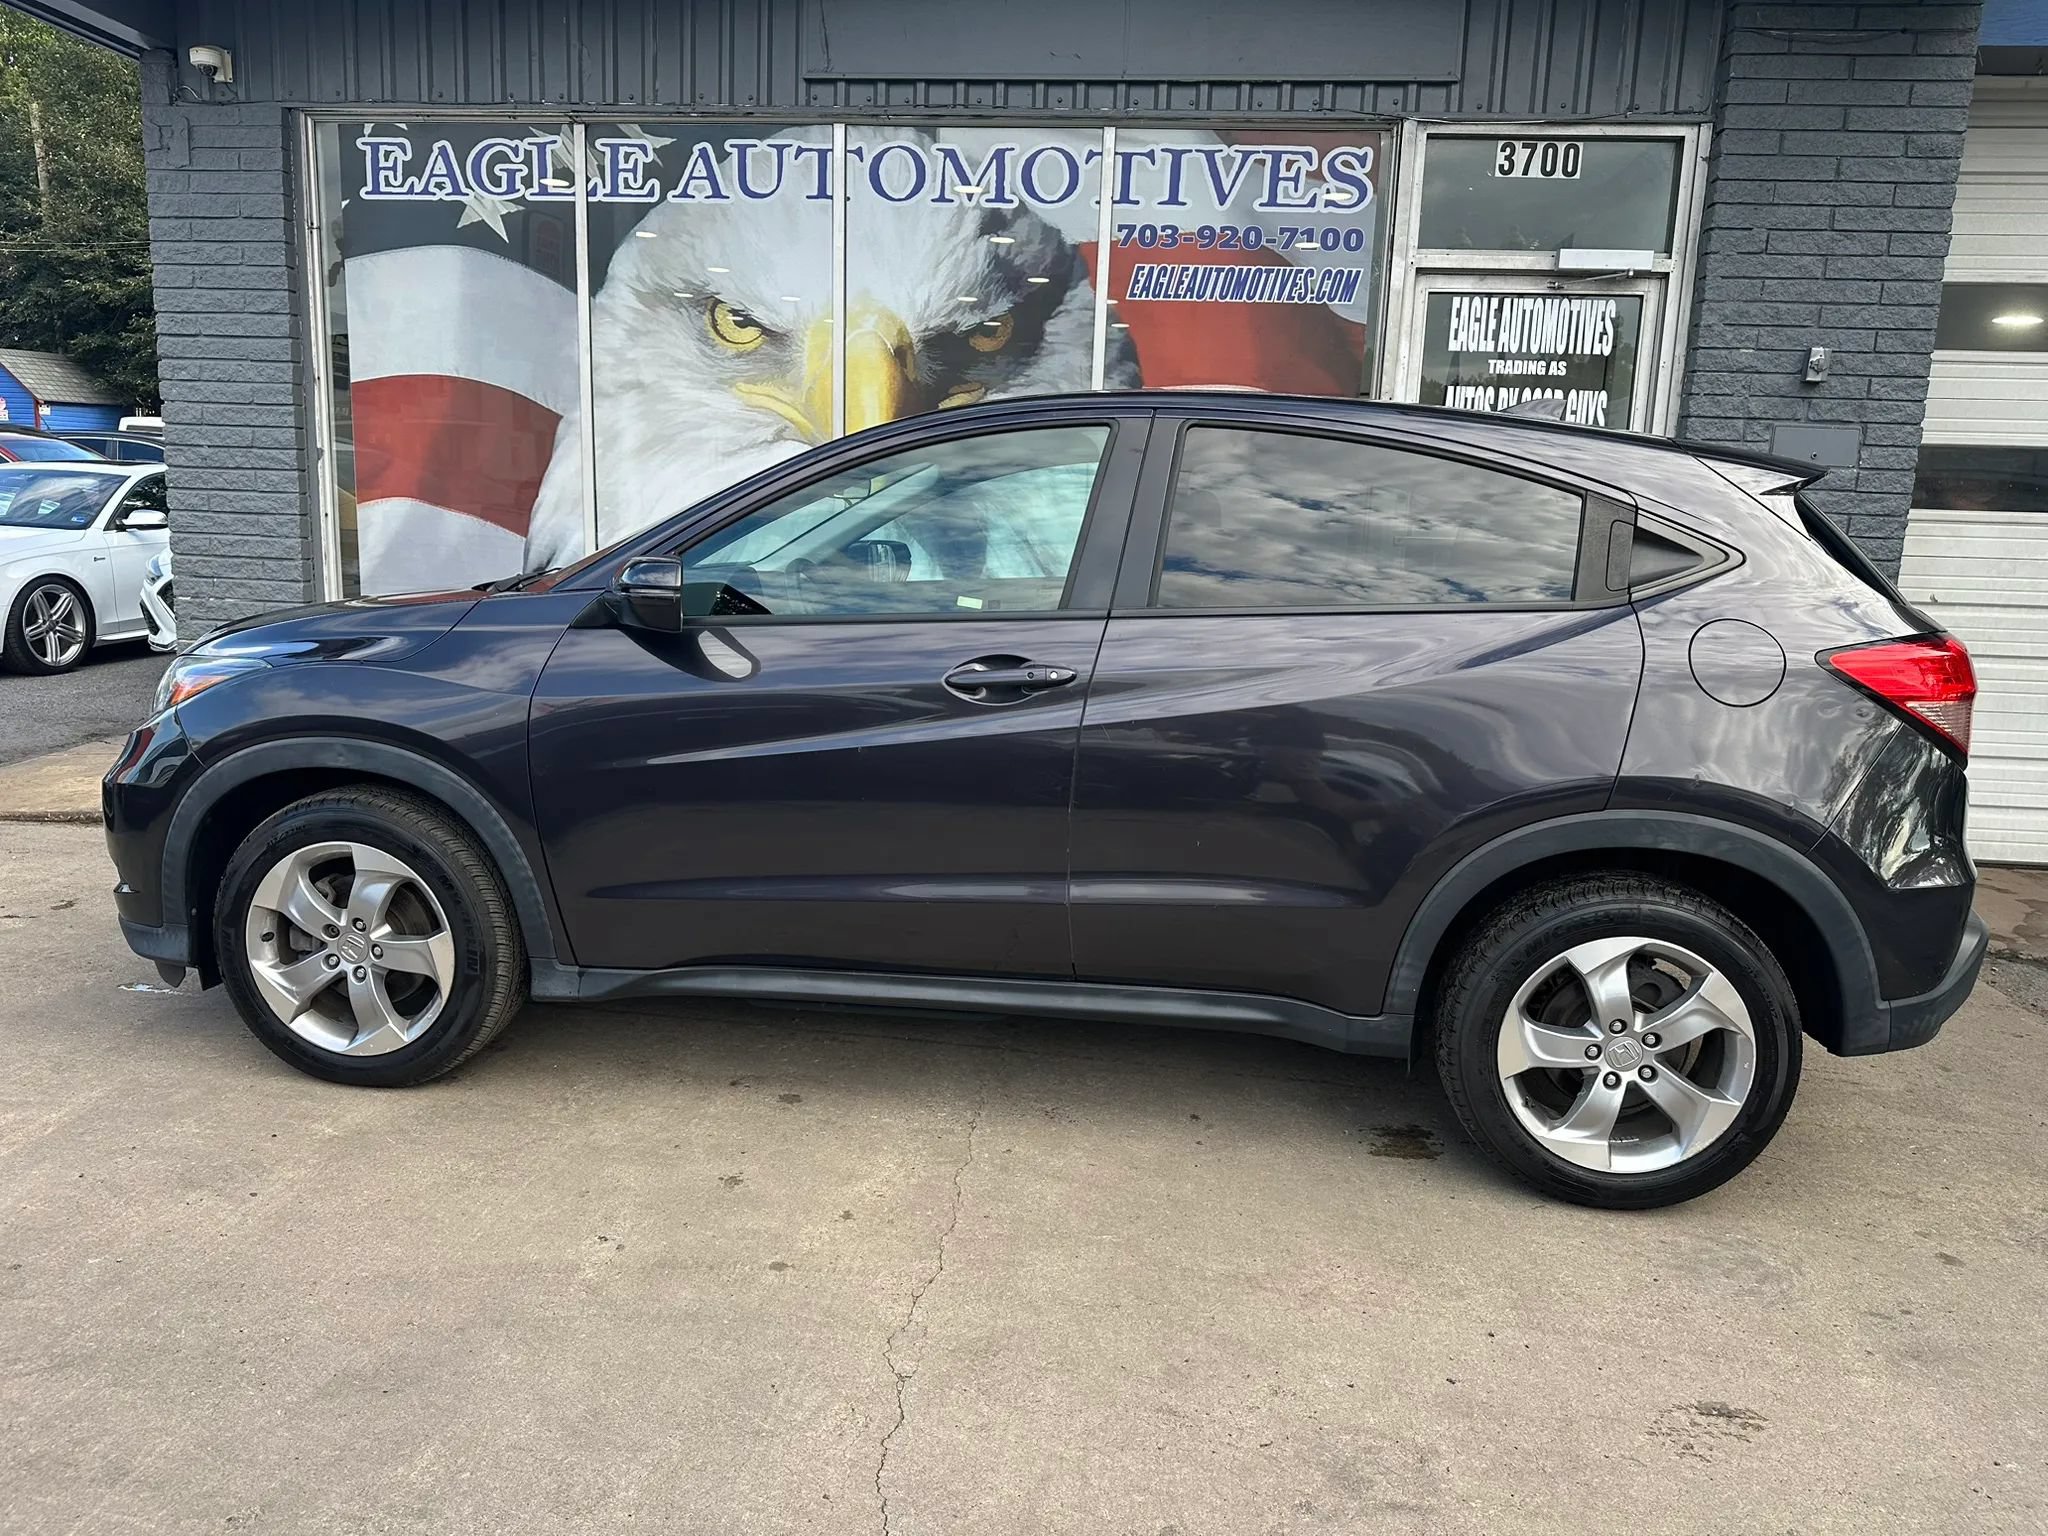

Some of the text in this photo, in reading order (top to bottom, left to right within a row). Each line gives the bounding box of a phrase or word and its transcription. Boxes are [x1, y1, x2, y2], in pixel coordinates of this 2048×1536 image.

[356, 136, 1374, 214] EAGLE AUTOMOTIVES
[1498, 141, 1581, 178] 3700
[1117, 223, 1365, 252] 703-920-7100
[1126, 263, 1363, 304] EAGLEAUTOMOTIVES.COM
[1448, 296, 1616, 357] EAGLE AUTOMOTIVES
[1488, 359, 1568, 377] TRADING AS
